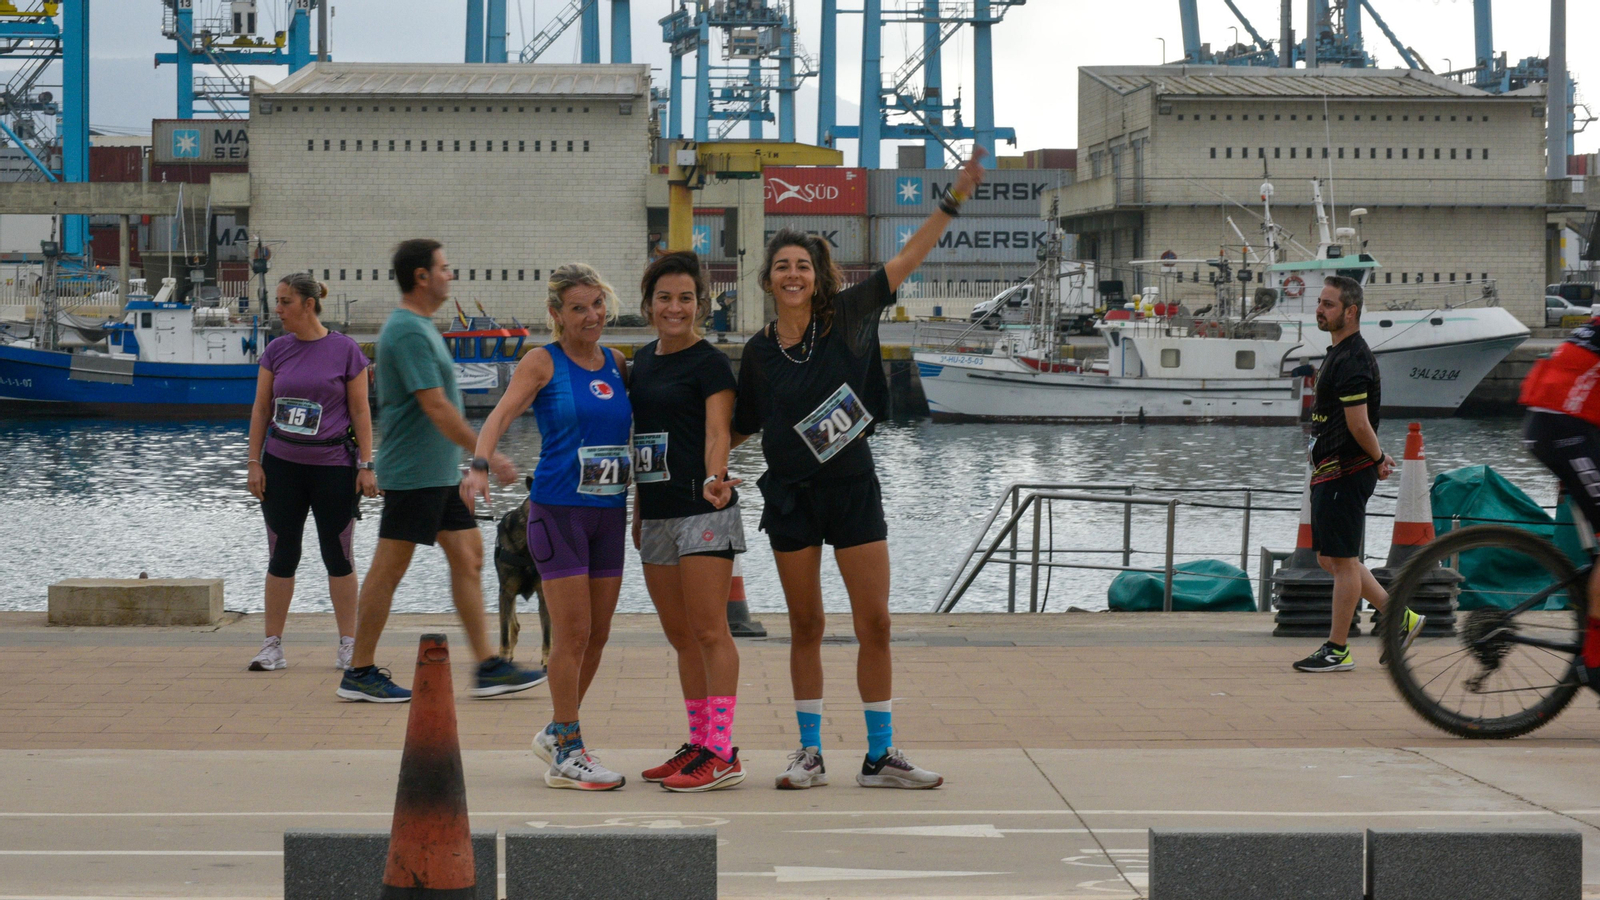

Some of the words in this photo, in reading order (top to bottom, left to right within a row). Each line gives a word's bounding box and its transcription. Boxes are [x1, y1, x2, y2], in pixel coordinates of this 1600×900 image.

[804, 183, 839, 200] SÜD
[932, 182, 1048, 200] MERSK
[934, 231, 1048, 249] MAERSK
[288, 407, 307, 426] 15
[818, 408, 853, 444] 20
[599, 458, 619, 485] 21
